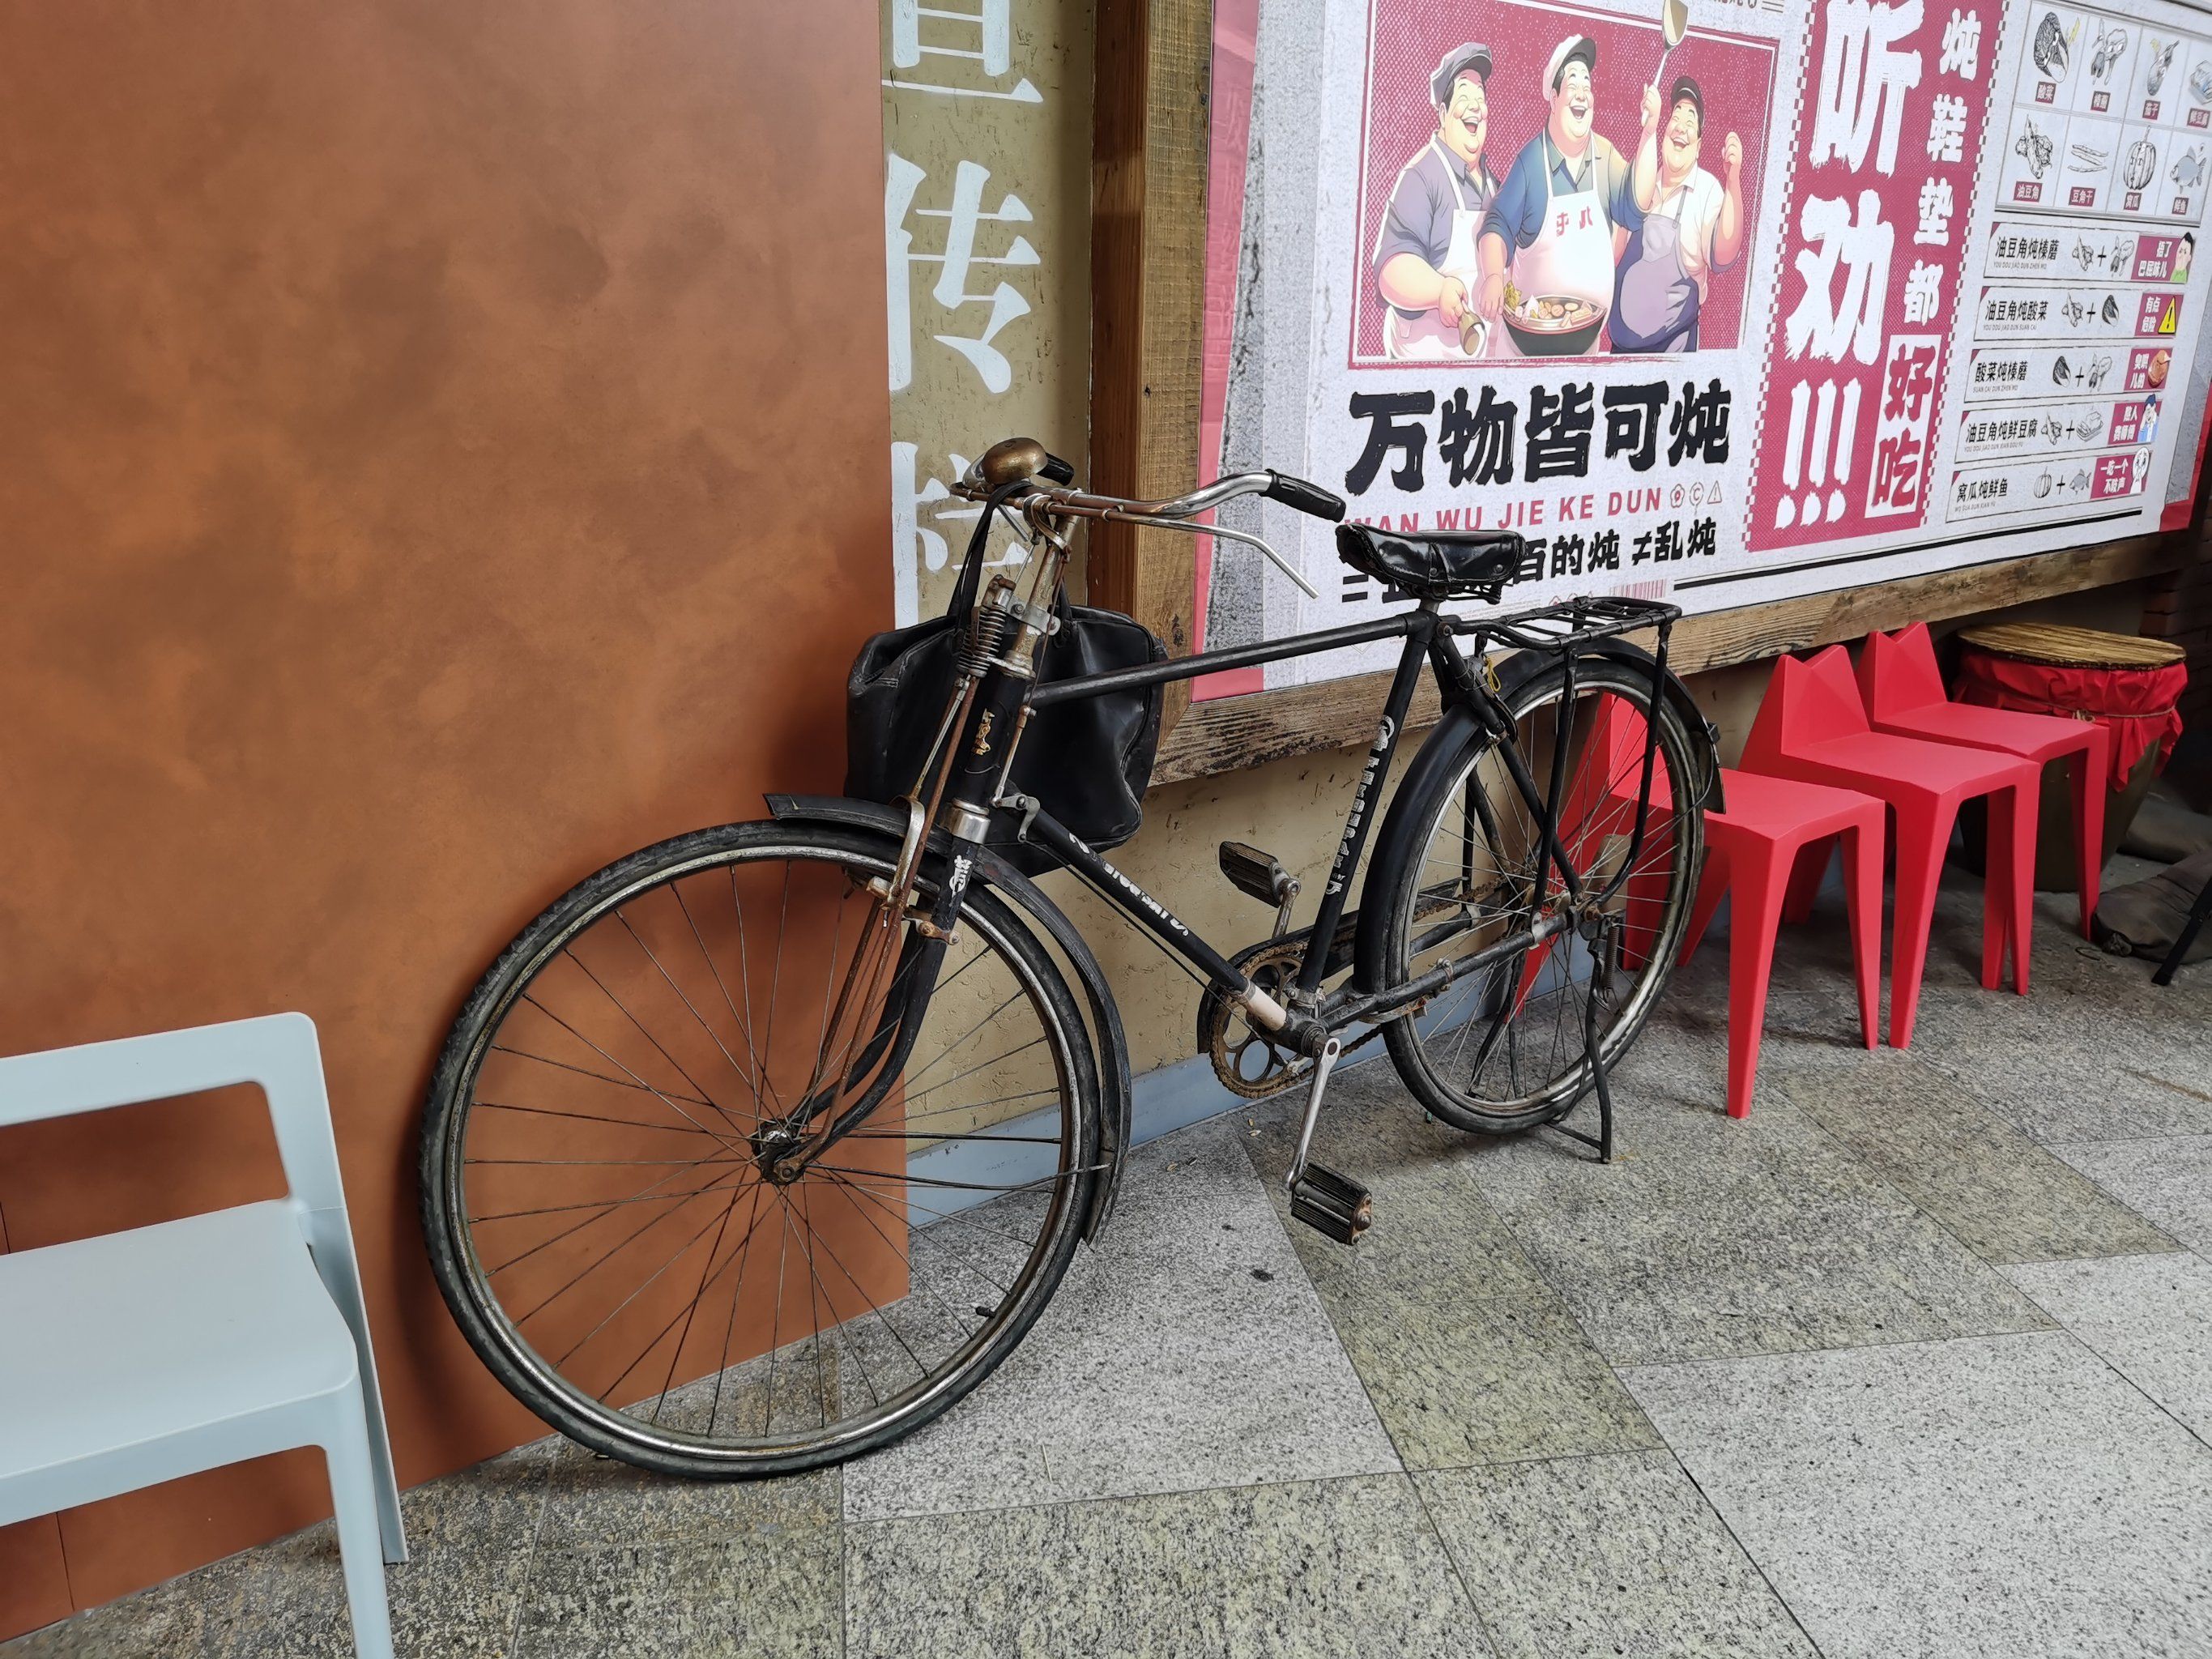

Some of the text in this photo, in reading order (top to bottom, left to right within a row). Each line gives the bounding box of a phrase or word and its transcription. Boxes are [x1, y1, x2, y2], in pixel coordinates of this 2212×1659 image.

[2038, 84, 2054, 100] 酸菜
[2017, 183, 2039, 199] 油豆角
[2072, 190, 2093, 203] 豆角干
[1995, 236, 2060, 260] 油豆角炖榛蘑
[1985, 300, 2048, 321] 油豆角炖酸菜
[2145, 296, 2161, 313] 有点
[1975, 360, 2028, 382] 酸菜炖榛蘑
[1345, 377, 1732, 497] 万物皆可炖
[1966, 418, 2038, 443] 油豆角炖鲜豆腐
[1957, 477, 2008, 503] 窝瓜炖鲜鱼
[1436, 506, 1482, 531] WU
[1498, 499, 1544, 529] JIE
[1558, 494, 1594, 522] KE
[1607, 487, 1660, 516] DUN
